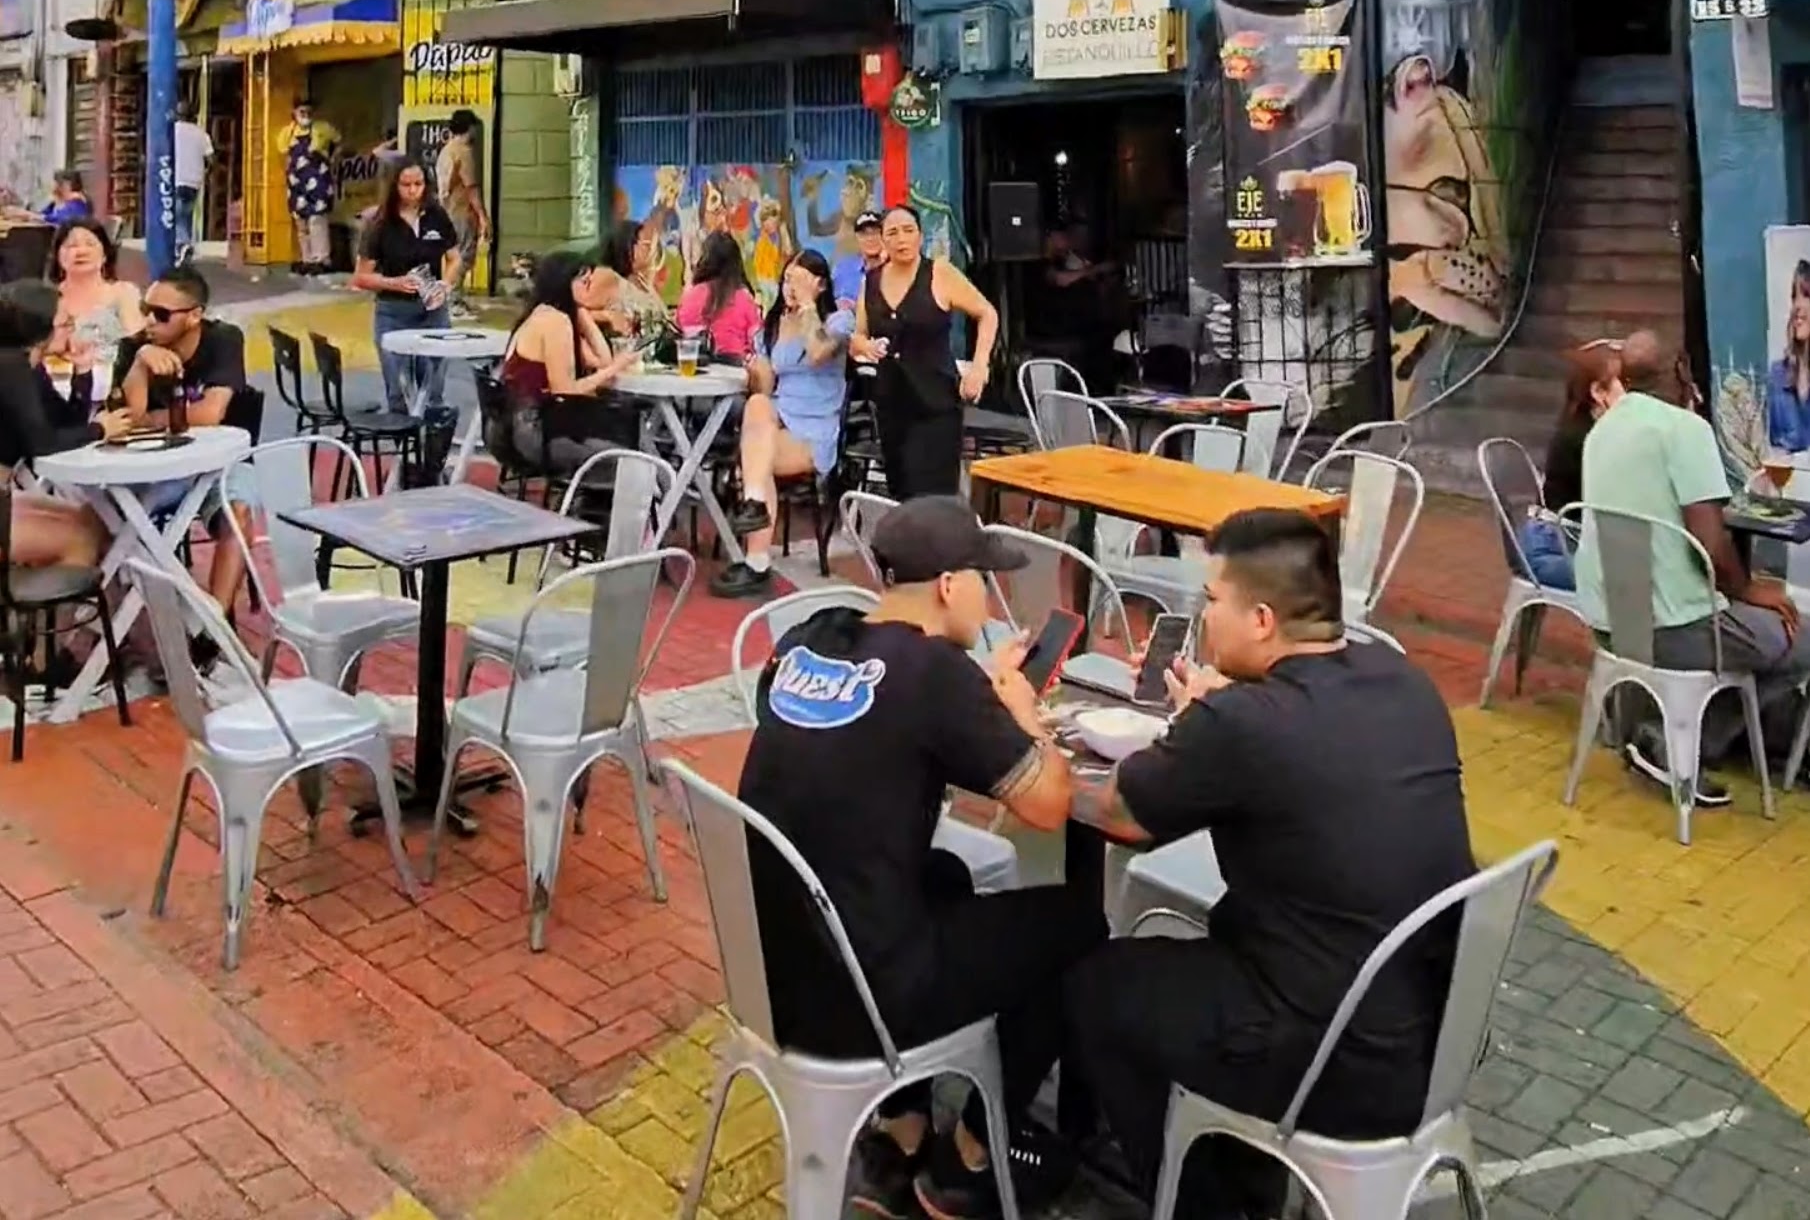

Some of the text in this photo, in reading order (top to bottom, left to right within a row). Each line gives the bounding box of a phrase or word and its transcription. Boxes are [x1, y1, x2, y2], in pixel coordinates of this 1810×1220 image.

[1045, 15, 1157, 39] DOS CERVEZAS
[1236, 190, 1264, 216] EJE
